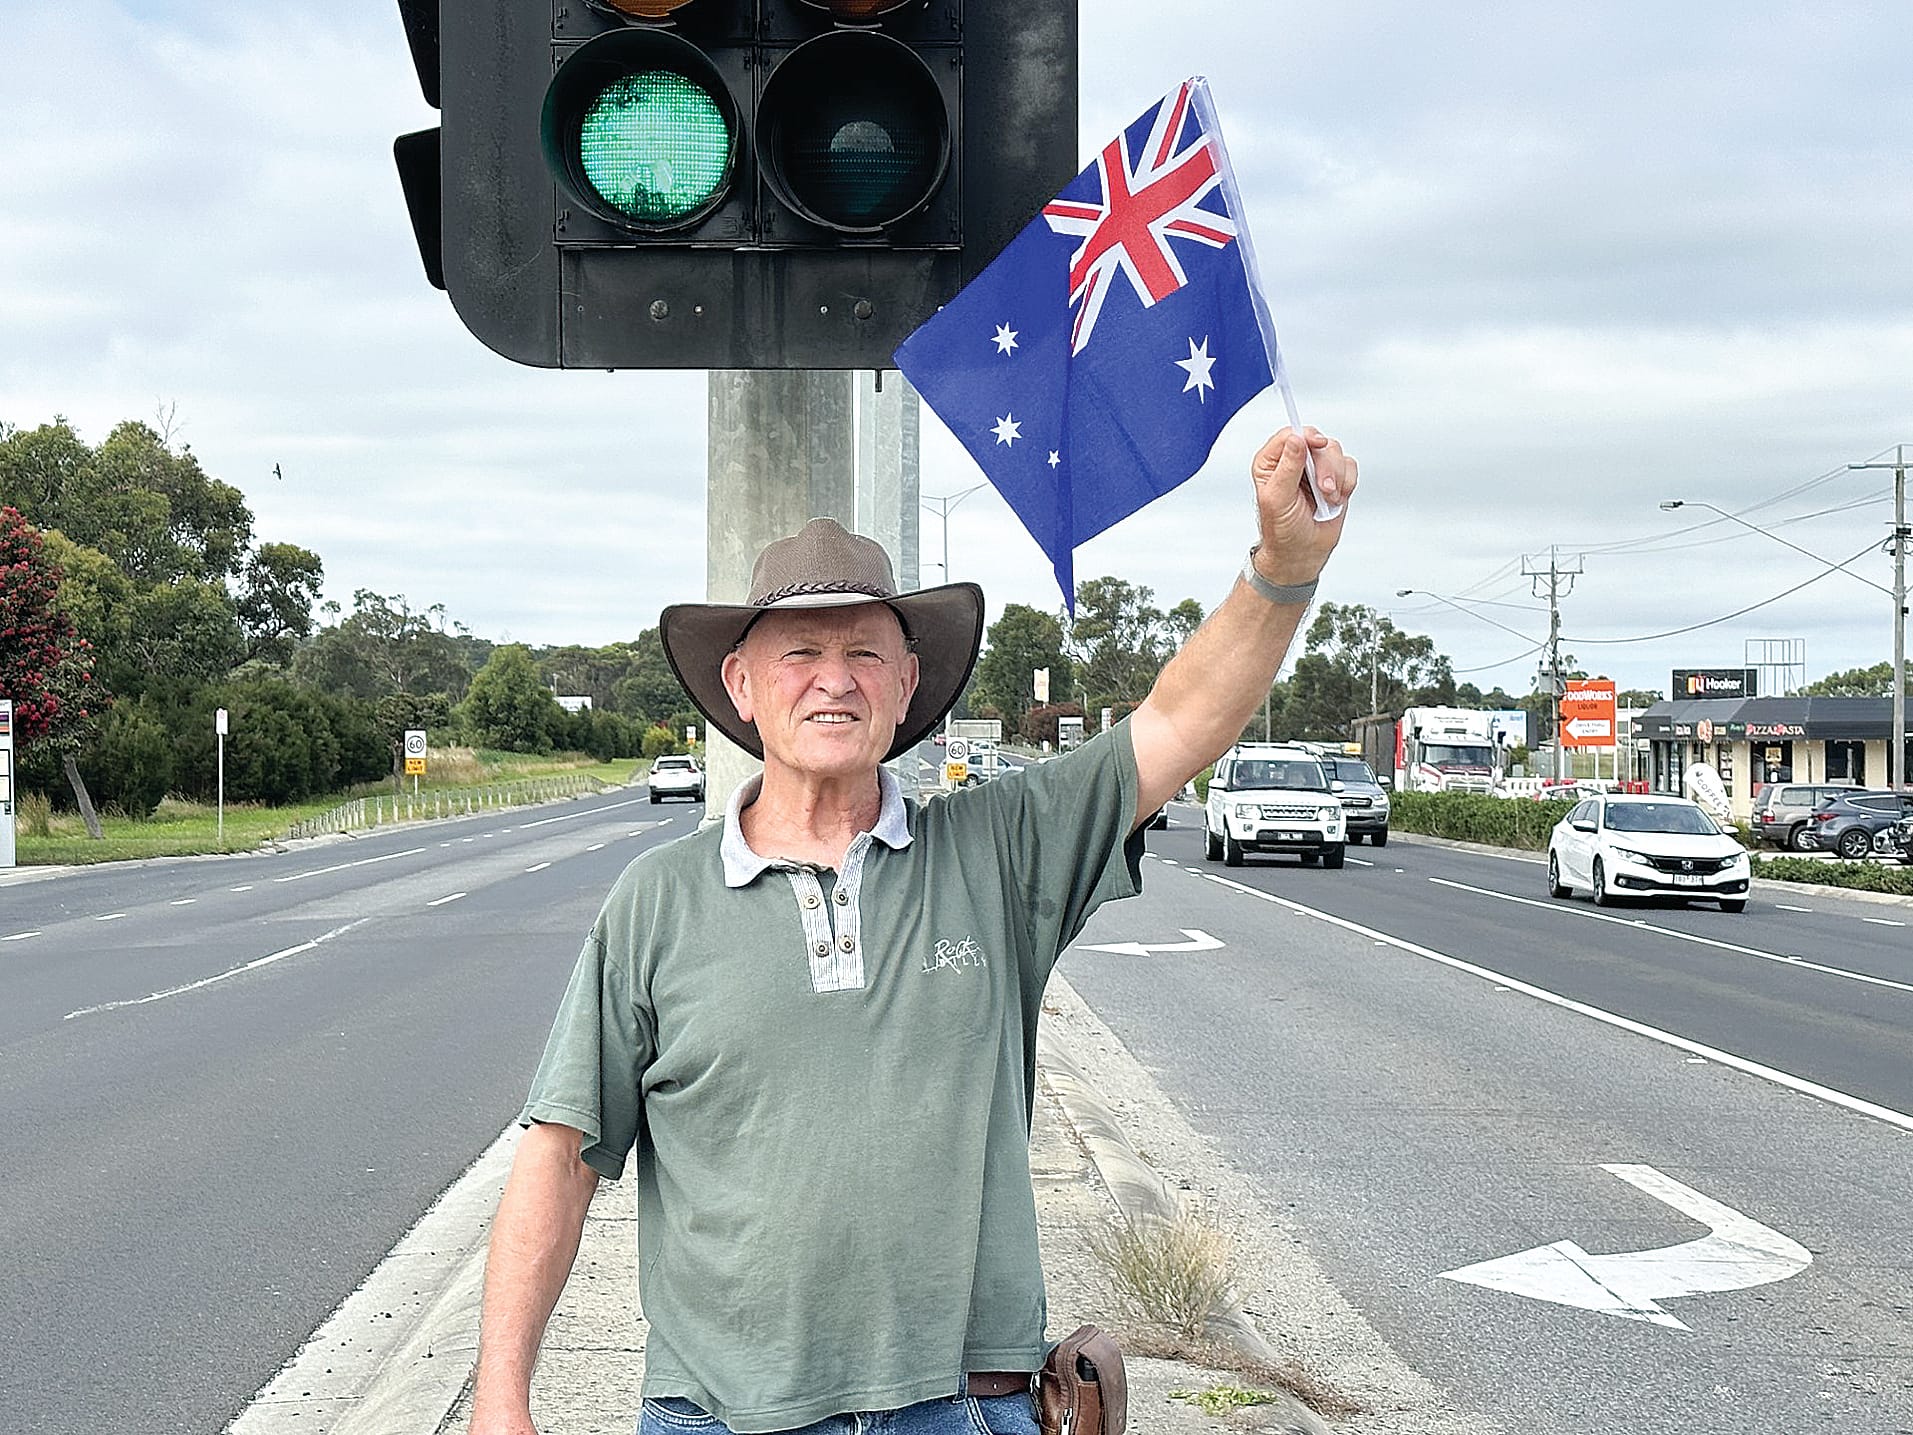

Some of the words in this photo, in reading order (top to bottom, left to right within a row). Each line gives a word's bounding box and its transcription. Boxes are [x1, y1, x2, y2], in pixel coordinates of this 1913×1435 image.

[1706, 677, 1741, 690] Hooker
[410, 740, 422, 749] 60
[951, 746, 963, 755] 60
[1697, 779, 1722, 807] COFFEE
